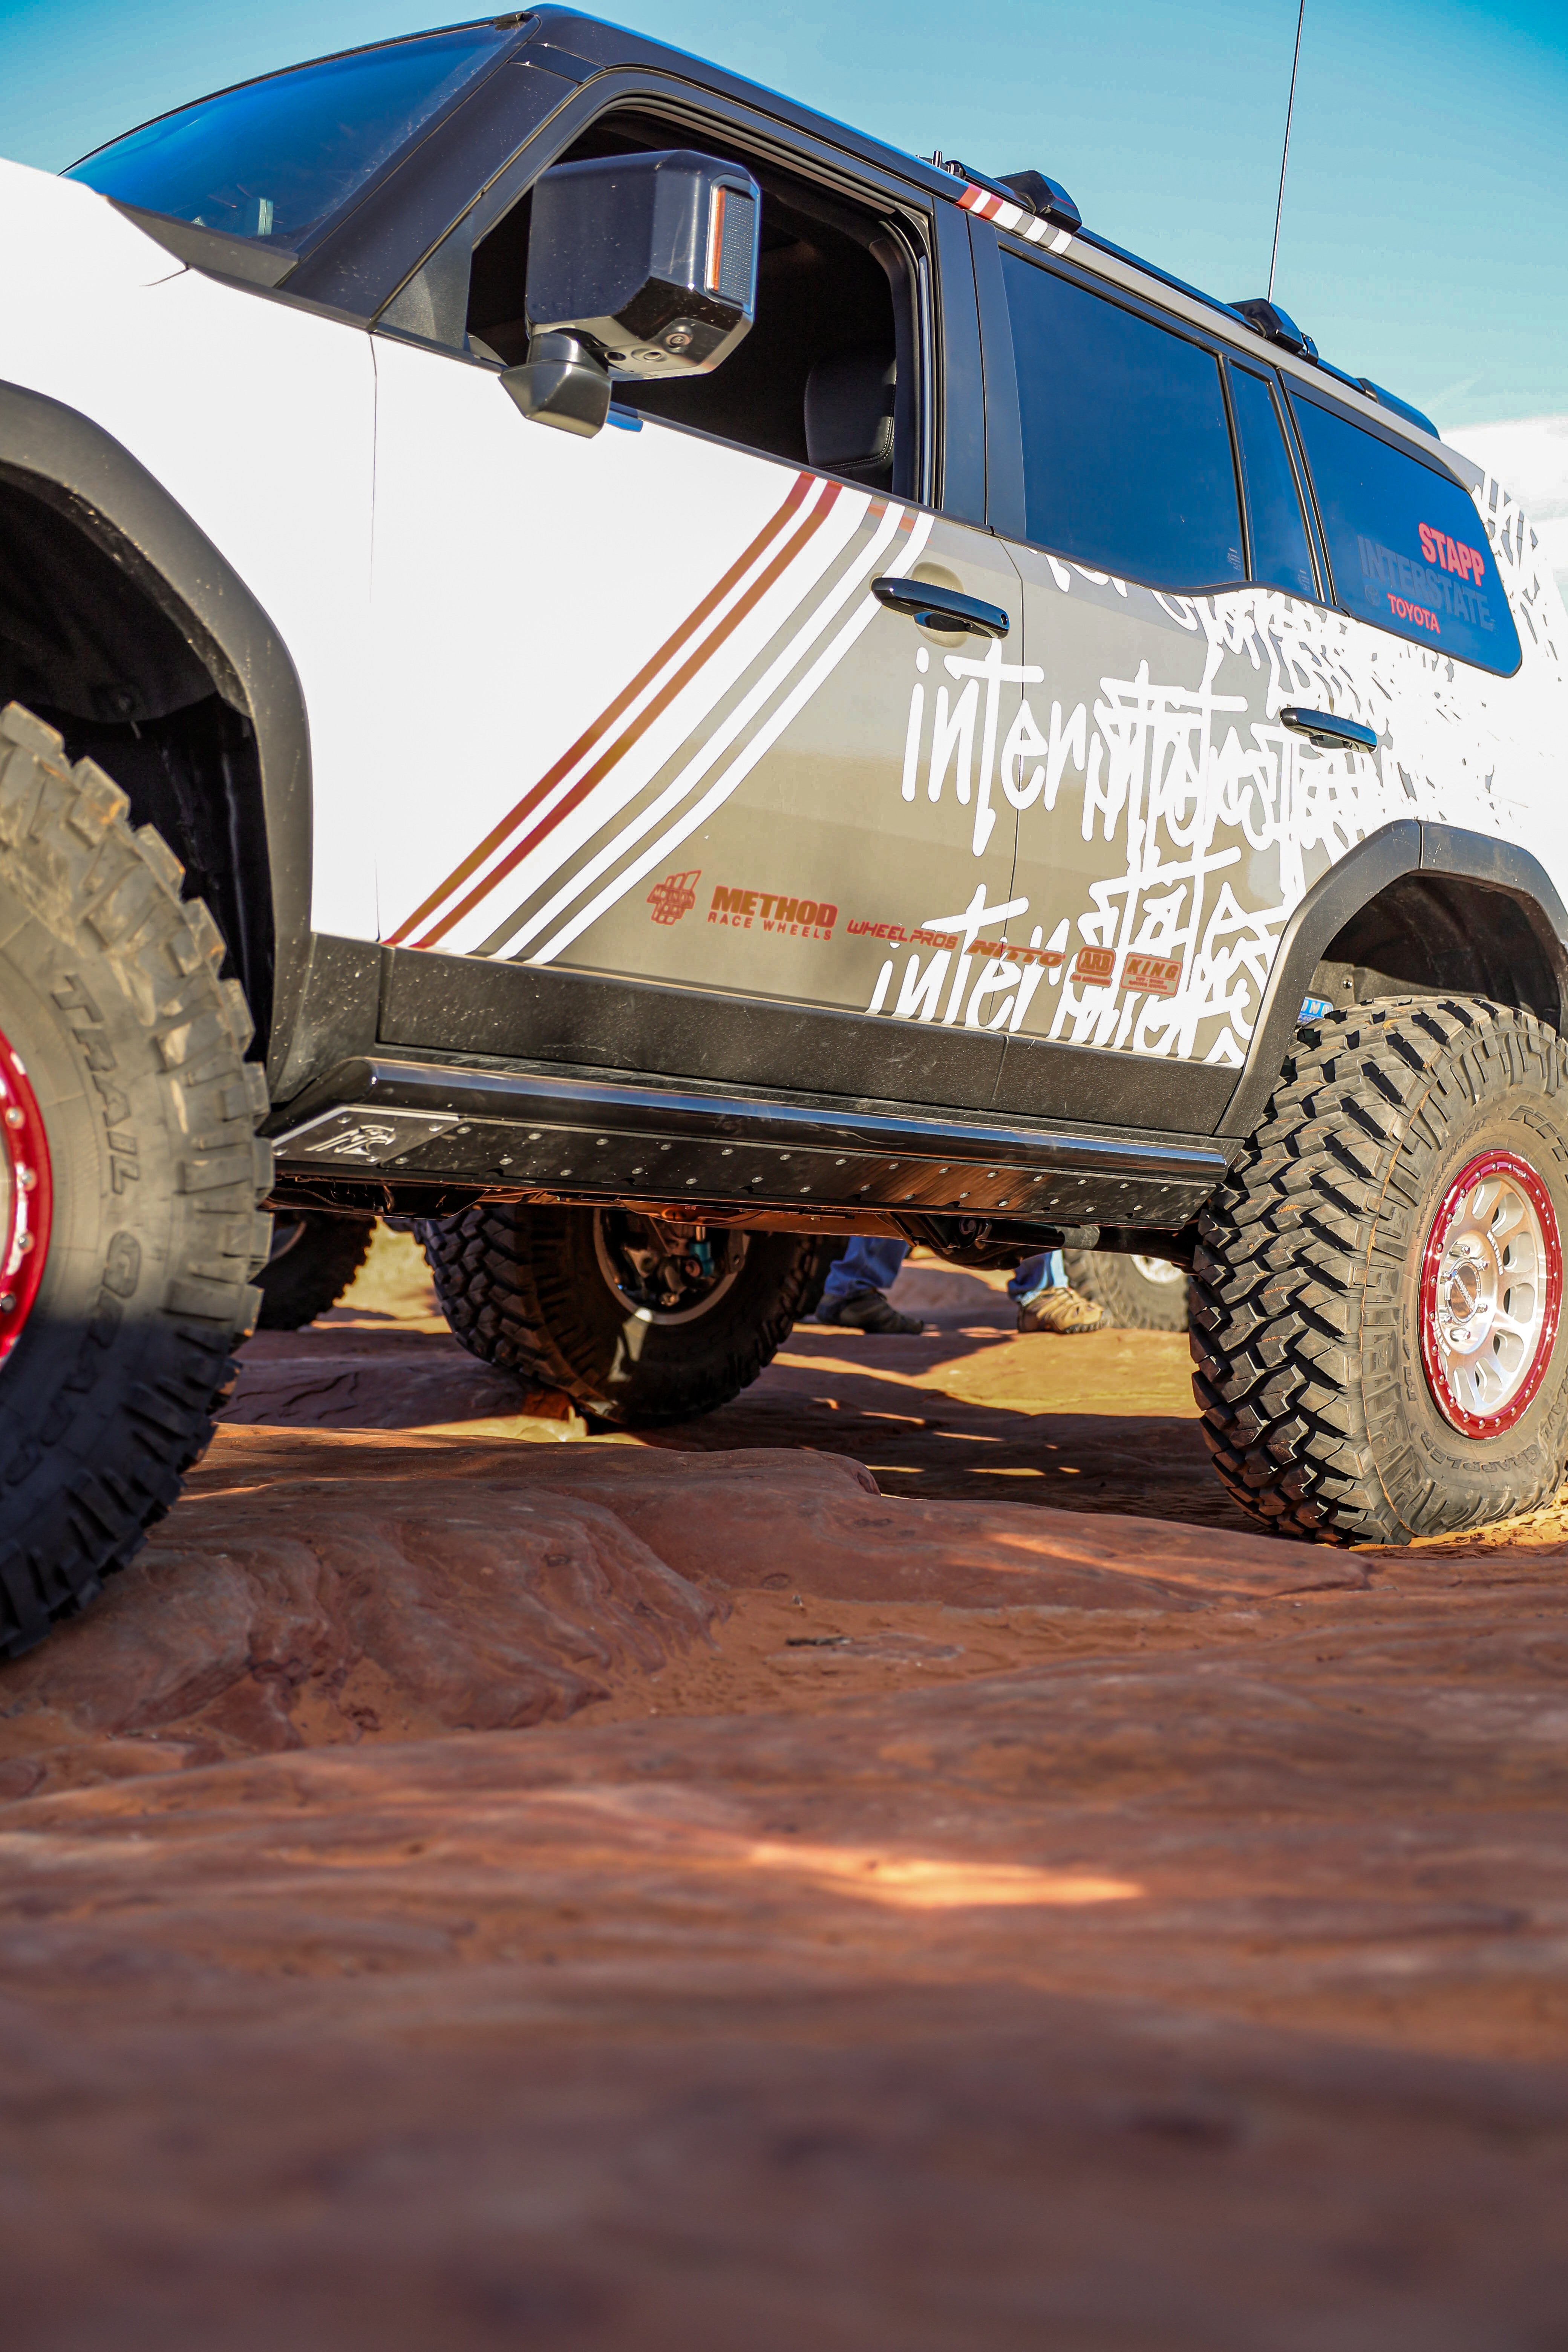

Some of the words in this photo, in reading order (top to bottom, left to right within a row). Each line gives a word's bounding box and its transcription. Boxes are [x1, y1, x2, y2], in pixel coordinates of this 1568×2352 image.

[1418, 522, 1485, 586] STAPP
[1357, 534, 1493, 631] INTERSTATE
[1387, 592, 1441, 634] TOYOTA
[707, 911, 753, 929] RACE
[763, 919, 832, 941] WHEELS
[710, 885, 838, 928] METHOD
[966, 939, 1063, 968] NITTO
[1080, 952, 1111, 972] ARB
[1127, 959, 1179, 980] KING
[51, 974, 139, 1195] TRAIL
[1421, 1432, 1540, 1472] GRAPPLER
